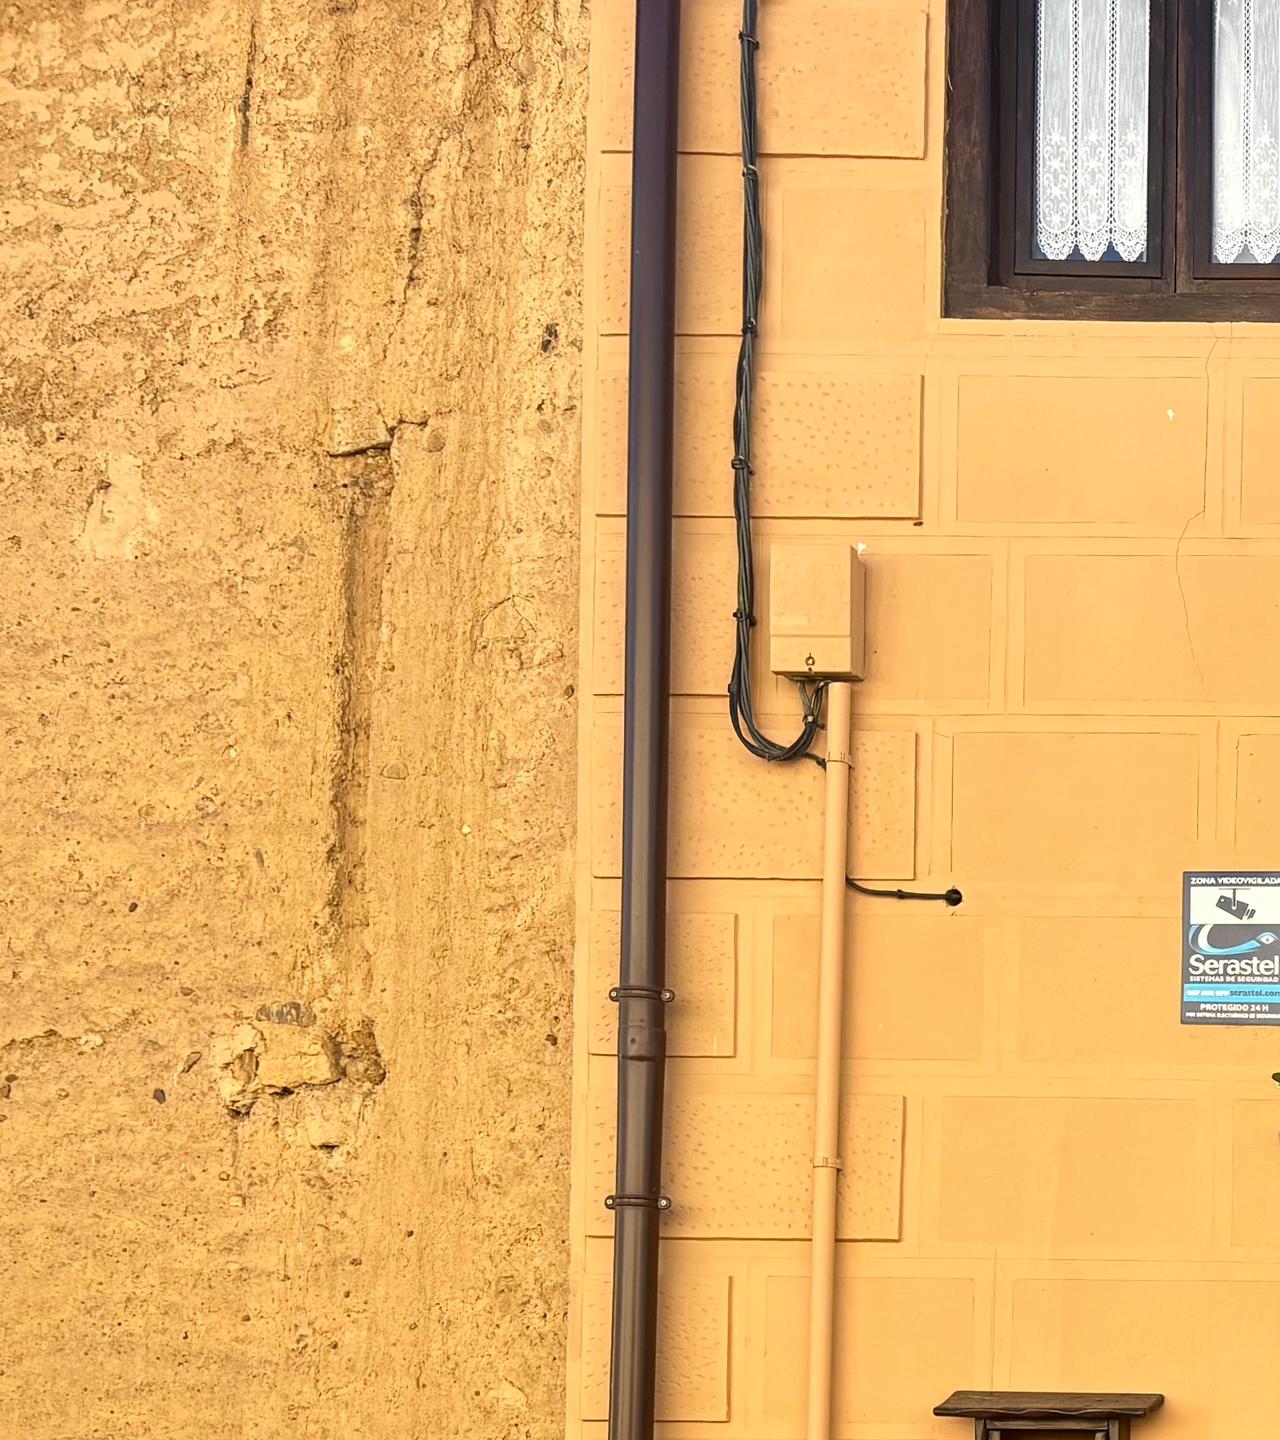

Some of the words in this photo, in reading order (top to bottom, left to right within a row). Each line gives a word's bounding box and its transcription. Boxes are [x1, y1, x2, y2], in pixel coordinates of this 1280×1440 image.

[1190, 877, 1216, 885] ZONA
[1188, 954, 1280, 976] Serastel
[1200, 1004, 1249, 1012] PROTEGIDO
[1262, 1004, 1269, 1012] H
